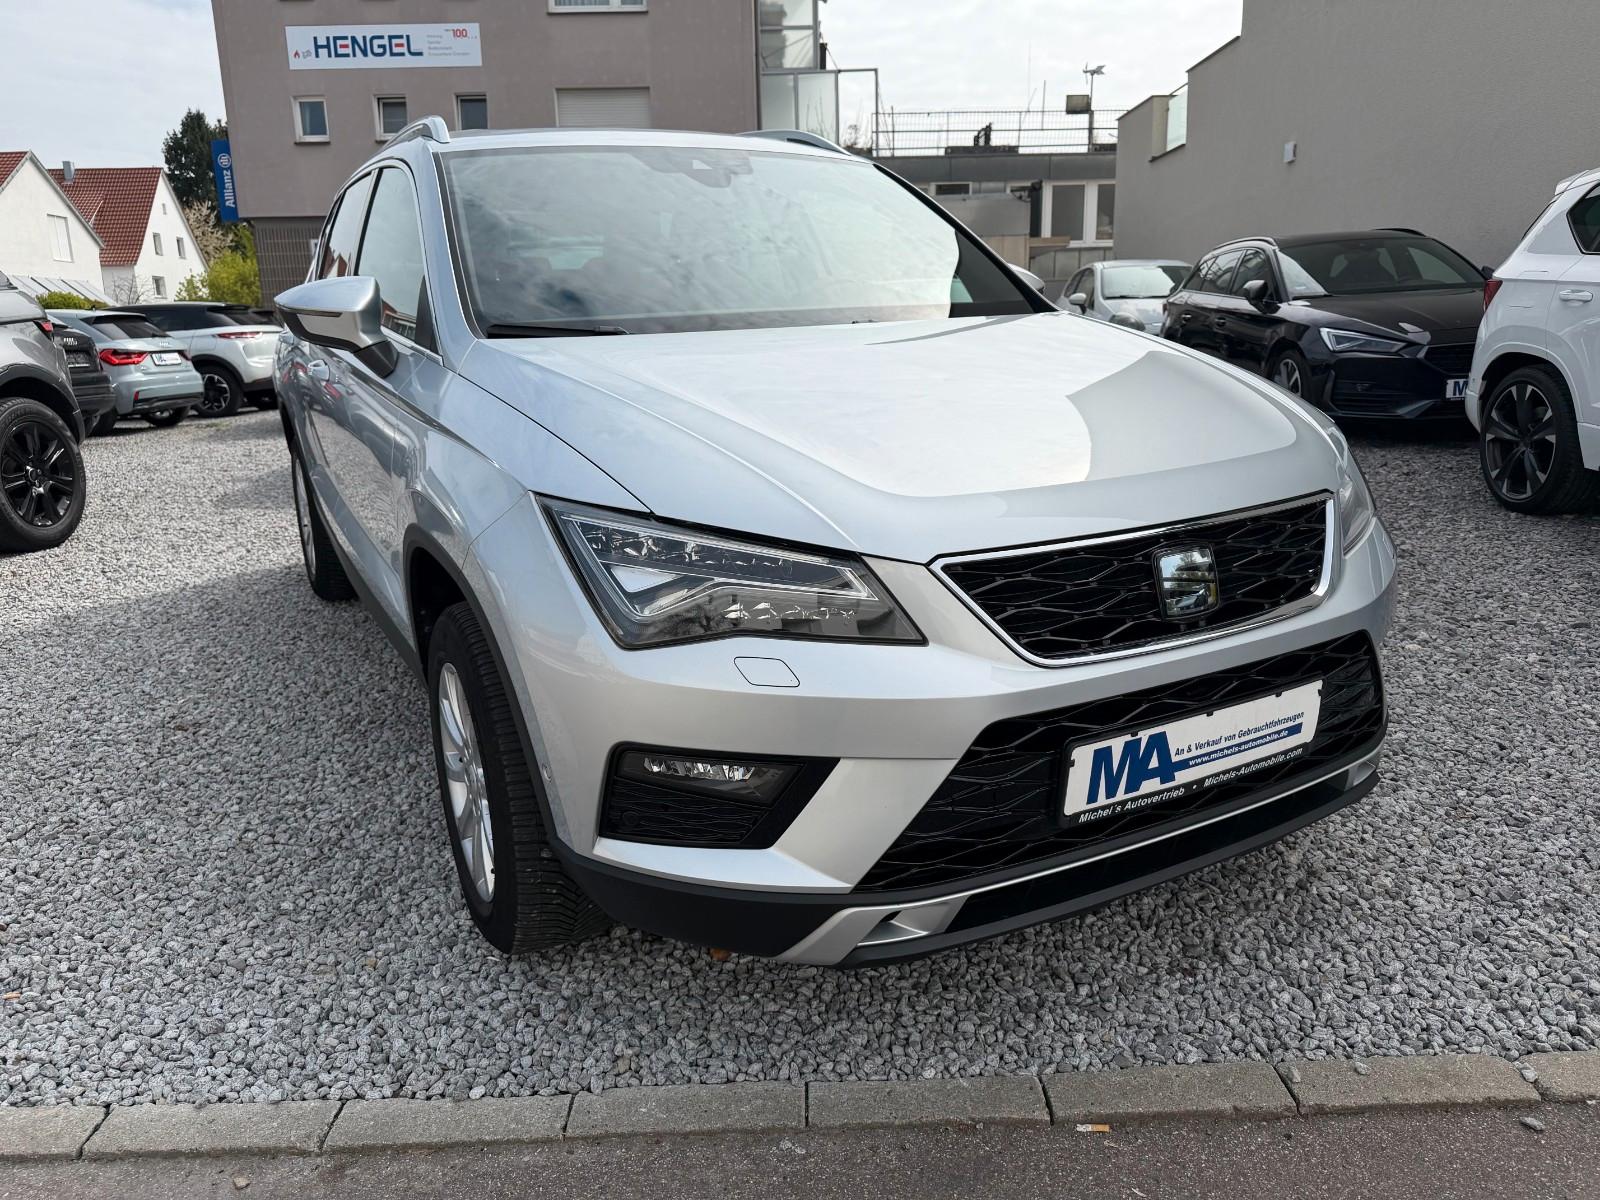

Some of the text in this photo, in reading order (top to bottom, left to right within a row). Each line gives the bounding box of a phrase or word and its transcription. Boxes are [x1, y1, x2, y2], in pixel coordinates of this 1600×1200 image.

[313, 34, 424, 58] HENGEL
[452, 28, 468, 38] 100
[223, 169, 236, 208] Allianz
[1174, 711, 1305, 757] An & Verkauf von Gebrauchtfahrzeugen
[1188, 729, 1289, 766] www.michels-automobile.de
[1086, 731, 1176, 805] MA
[1123, 787, 1186, 811] Autovertrieb
[1203, 748, 1304, 788] Michels-Automobile.com
